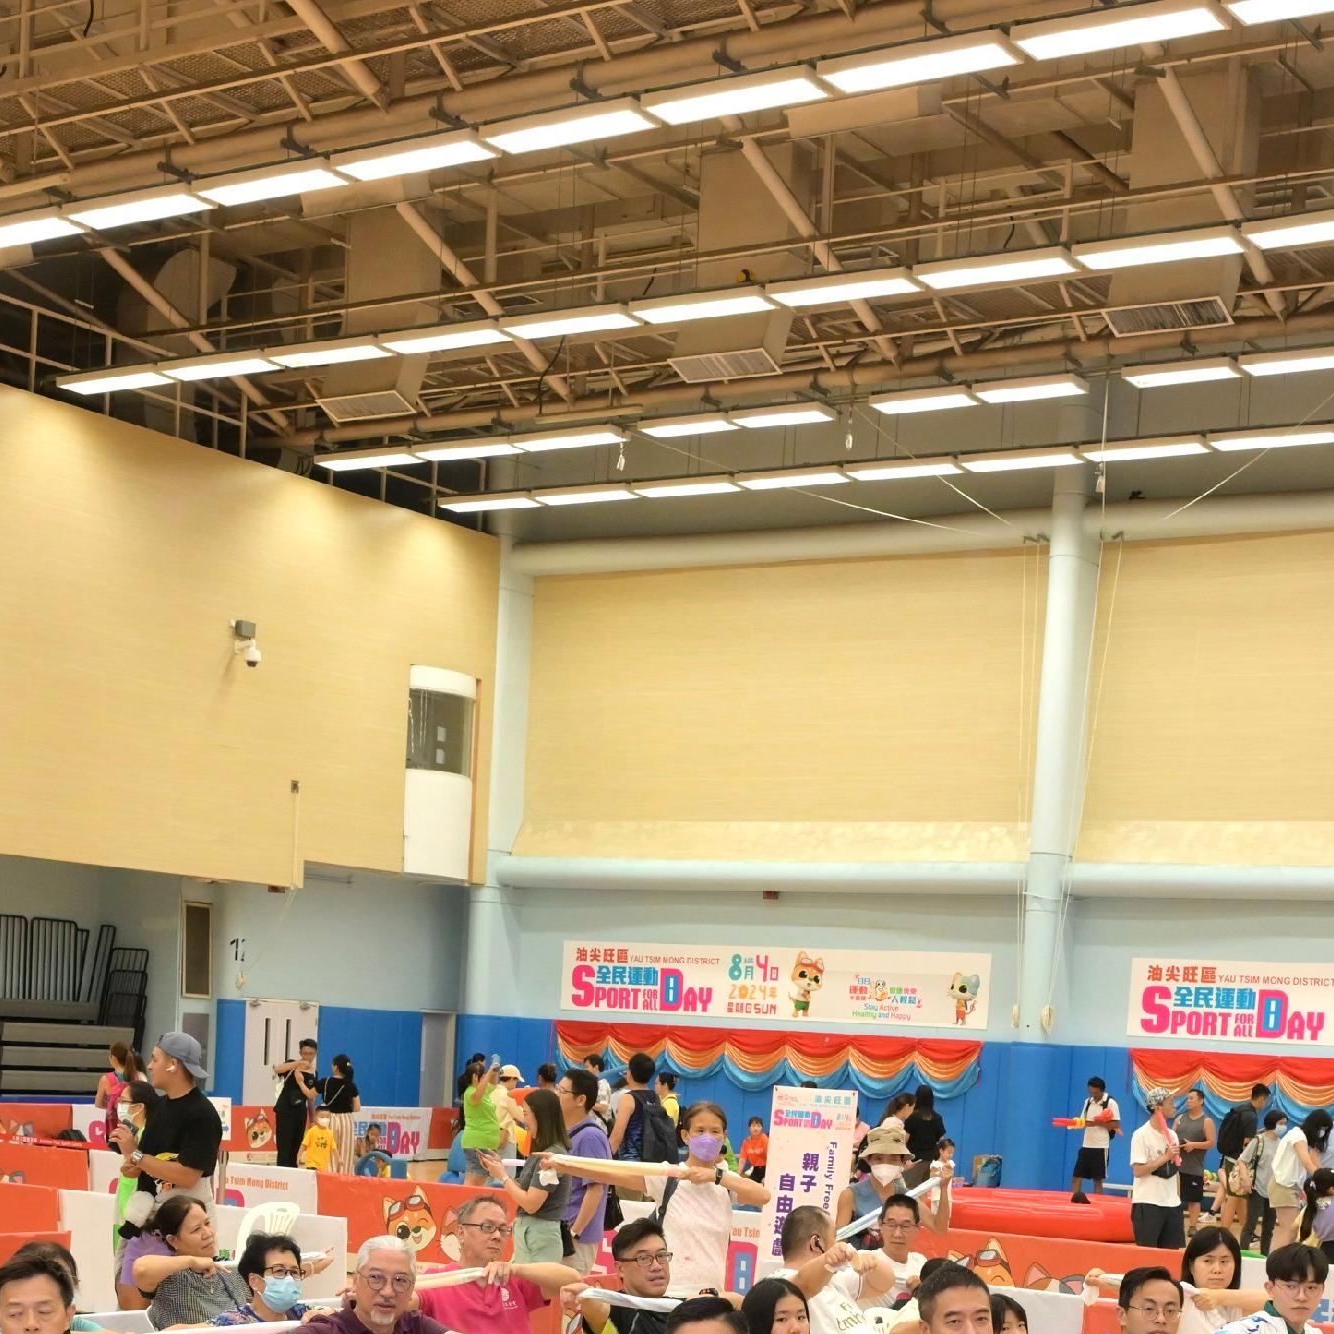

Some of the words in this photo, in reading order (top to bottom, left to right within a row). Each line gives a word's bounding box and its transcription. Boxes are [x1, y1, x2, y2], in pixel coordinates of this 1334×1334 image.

[576, 948, 629, 964] 油尖旺區
[572, 964, 642, 1010] SPORT
[596, 965, 658, 986] 全民運動
[1148, 965, 1217, 983] 油尖旺區
[1218, 975, 1236, 984] YAU
[1239, 975, 1260, 985] TSIM
[643, 988, 658, 1000] FOR
[660, 968, 713, 1012] DAY
[1174, 986, 1256, 1010] 全民運動
[642, 999, 657, 1011] ALL
[1141, 985, 1232, 1035] SPORT
[1256, 989, 1325, 1041] DAY
[1235, 1012, 1254, 1024] FOR
[1234, 1024, 1253, 1038] ALL
[388, 1121, 420, 1154] DAY
[800, 1152, 820, 1193] 親子
[824, 1141, 838, 1181] Family
